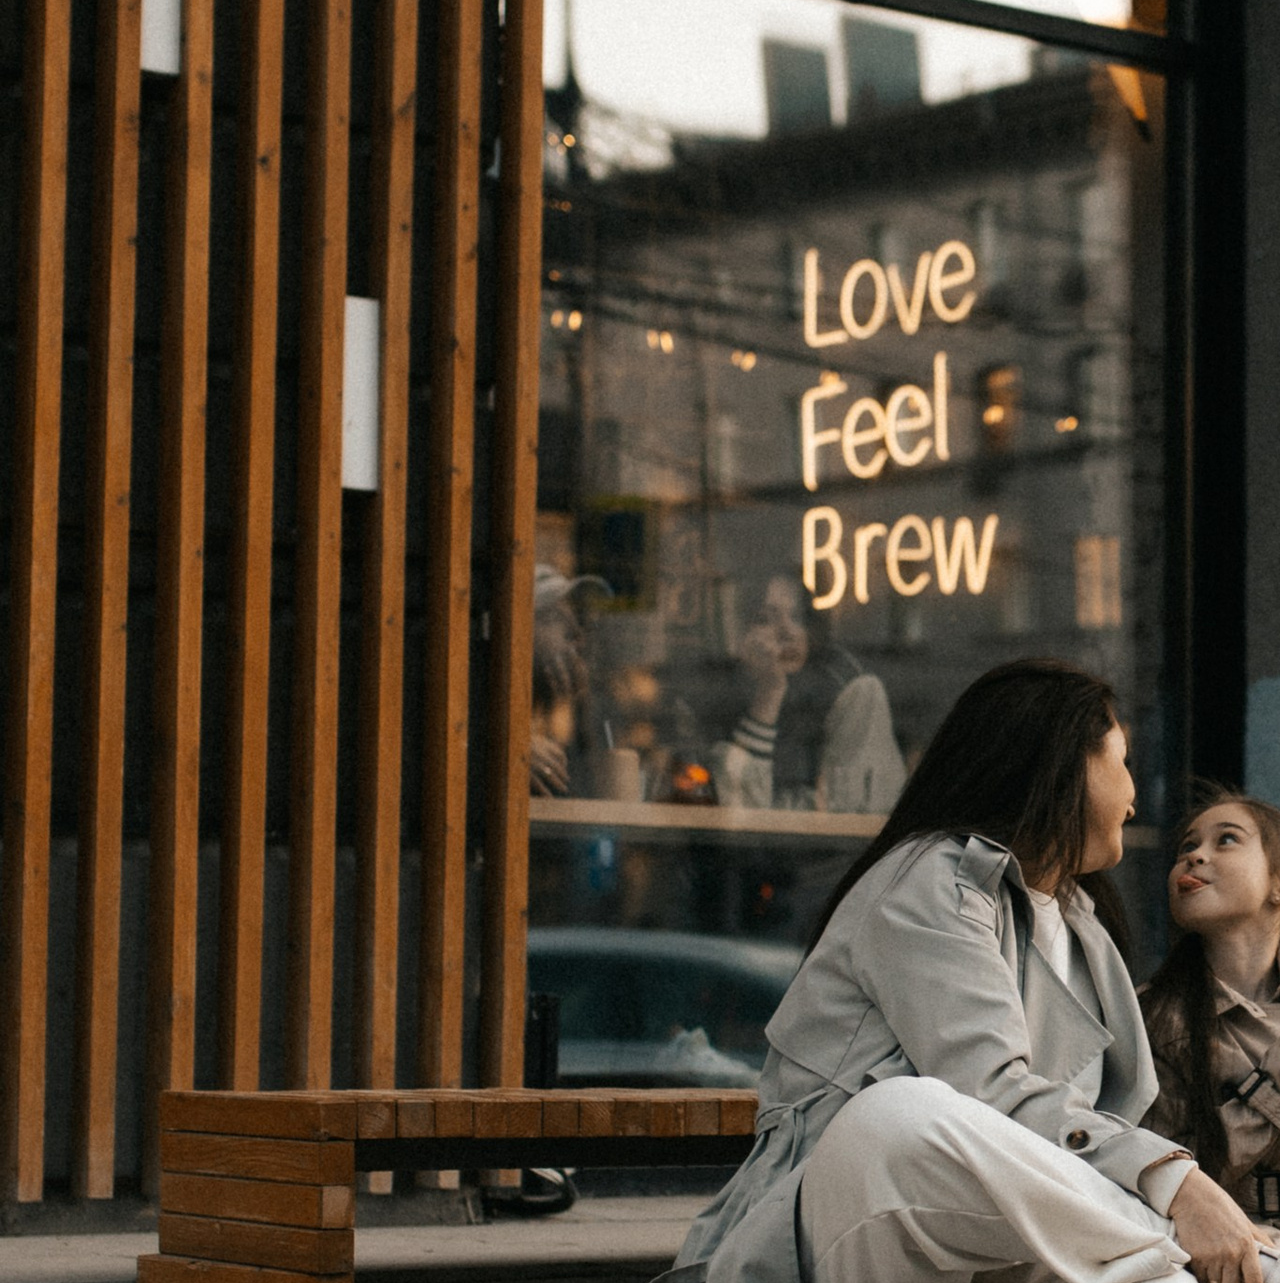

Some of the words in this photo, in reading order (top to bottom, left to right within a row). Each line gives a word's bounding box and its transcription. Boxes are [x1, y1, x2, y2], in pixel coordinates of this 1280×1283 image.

[803, 239, 977, 349] Love
[801, 350, 951, 492] Feel
[802, 505, 999, 610] Brew
